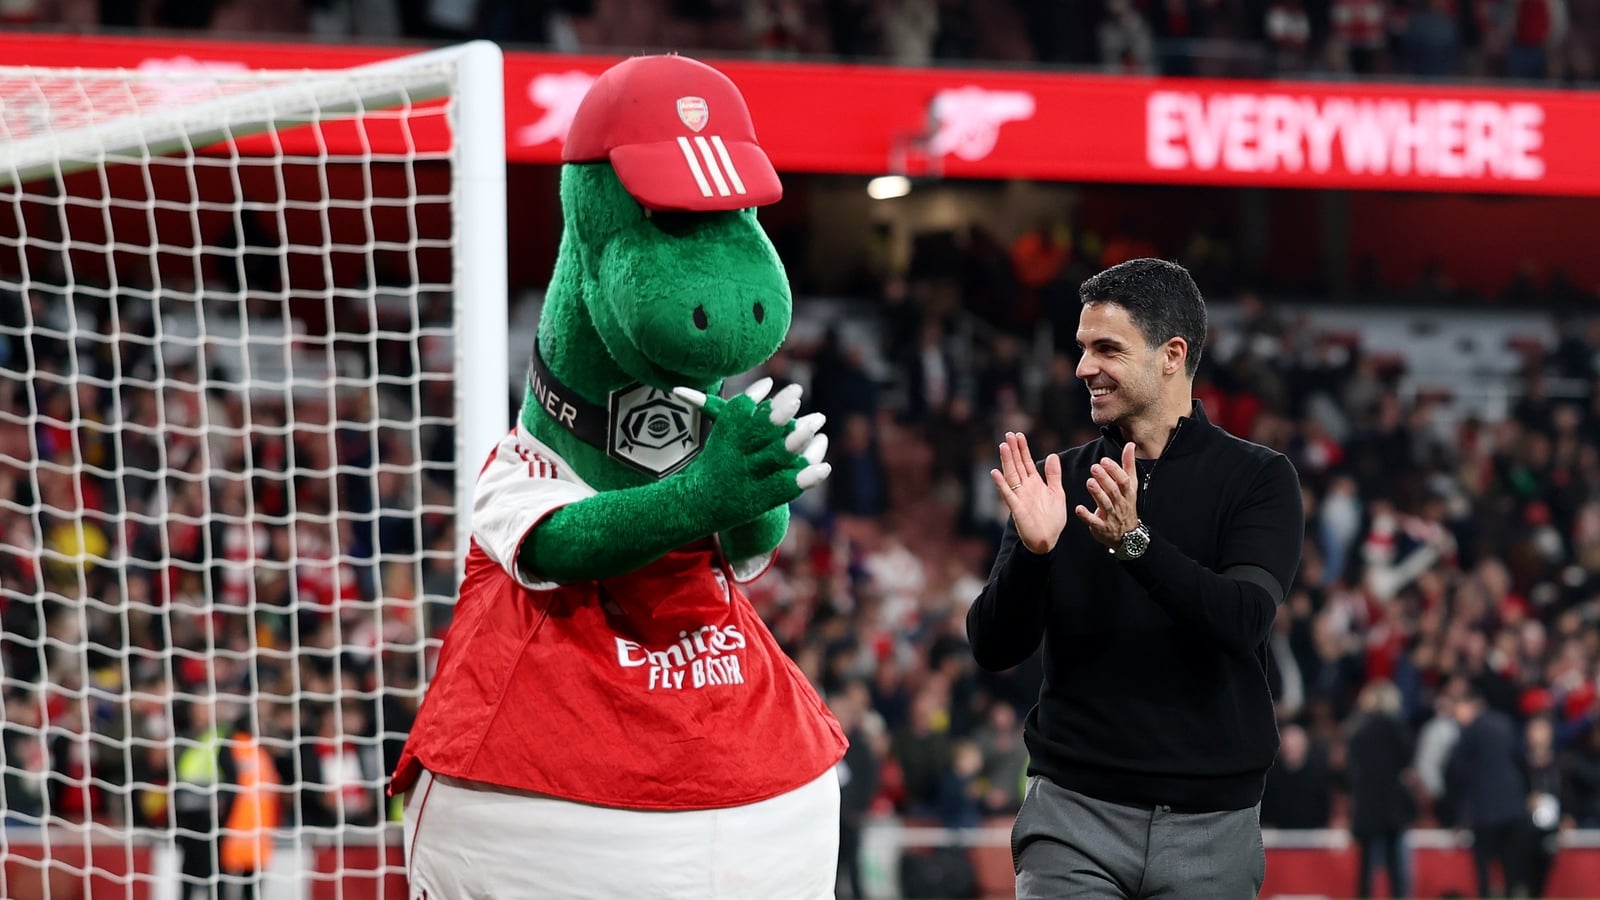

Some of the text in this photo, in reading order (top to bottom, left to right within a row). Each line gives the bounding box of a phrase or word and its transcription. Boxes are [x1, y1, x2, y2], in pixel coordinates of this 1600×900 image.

[1147, 91, 1545, 180] EVERYWHERE
[615, 625, 746, 668] Emires
[649, 666, 685, 690] FLY
